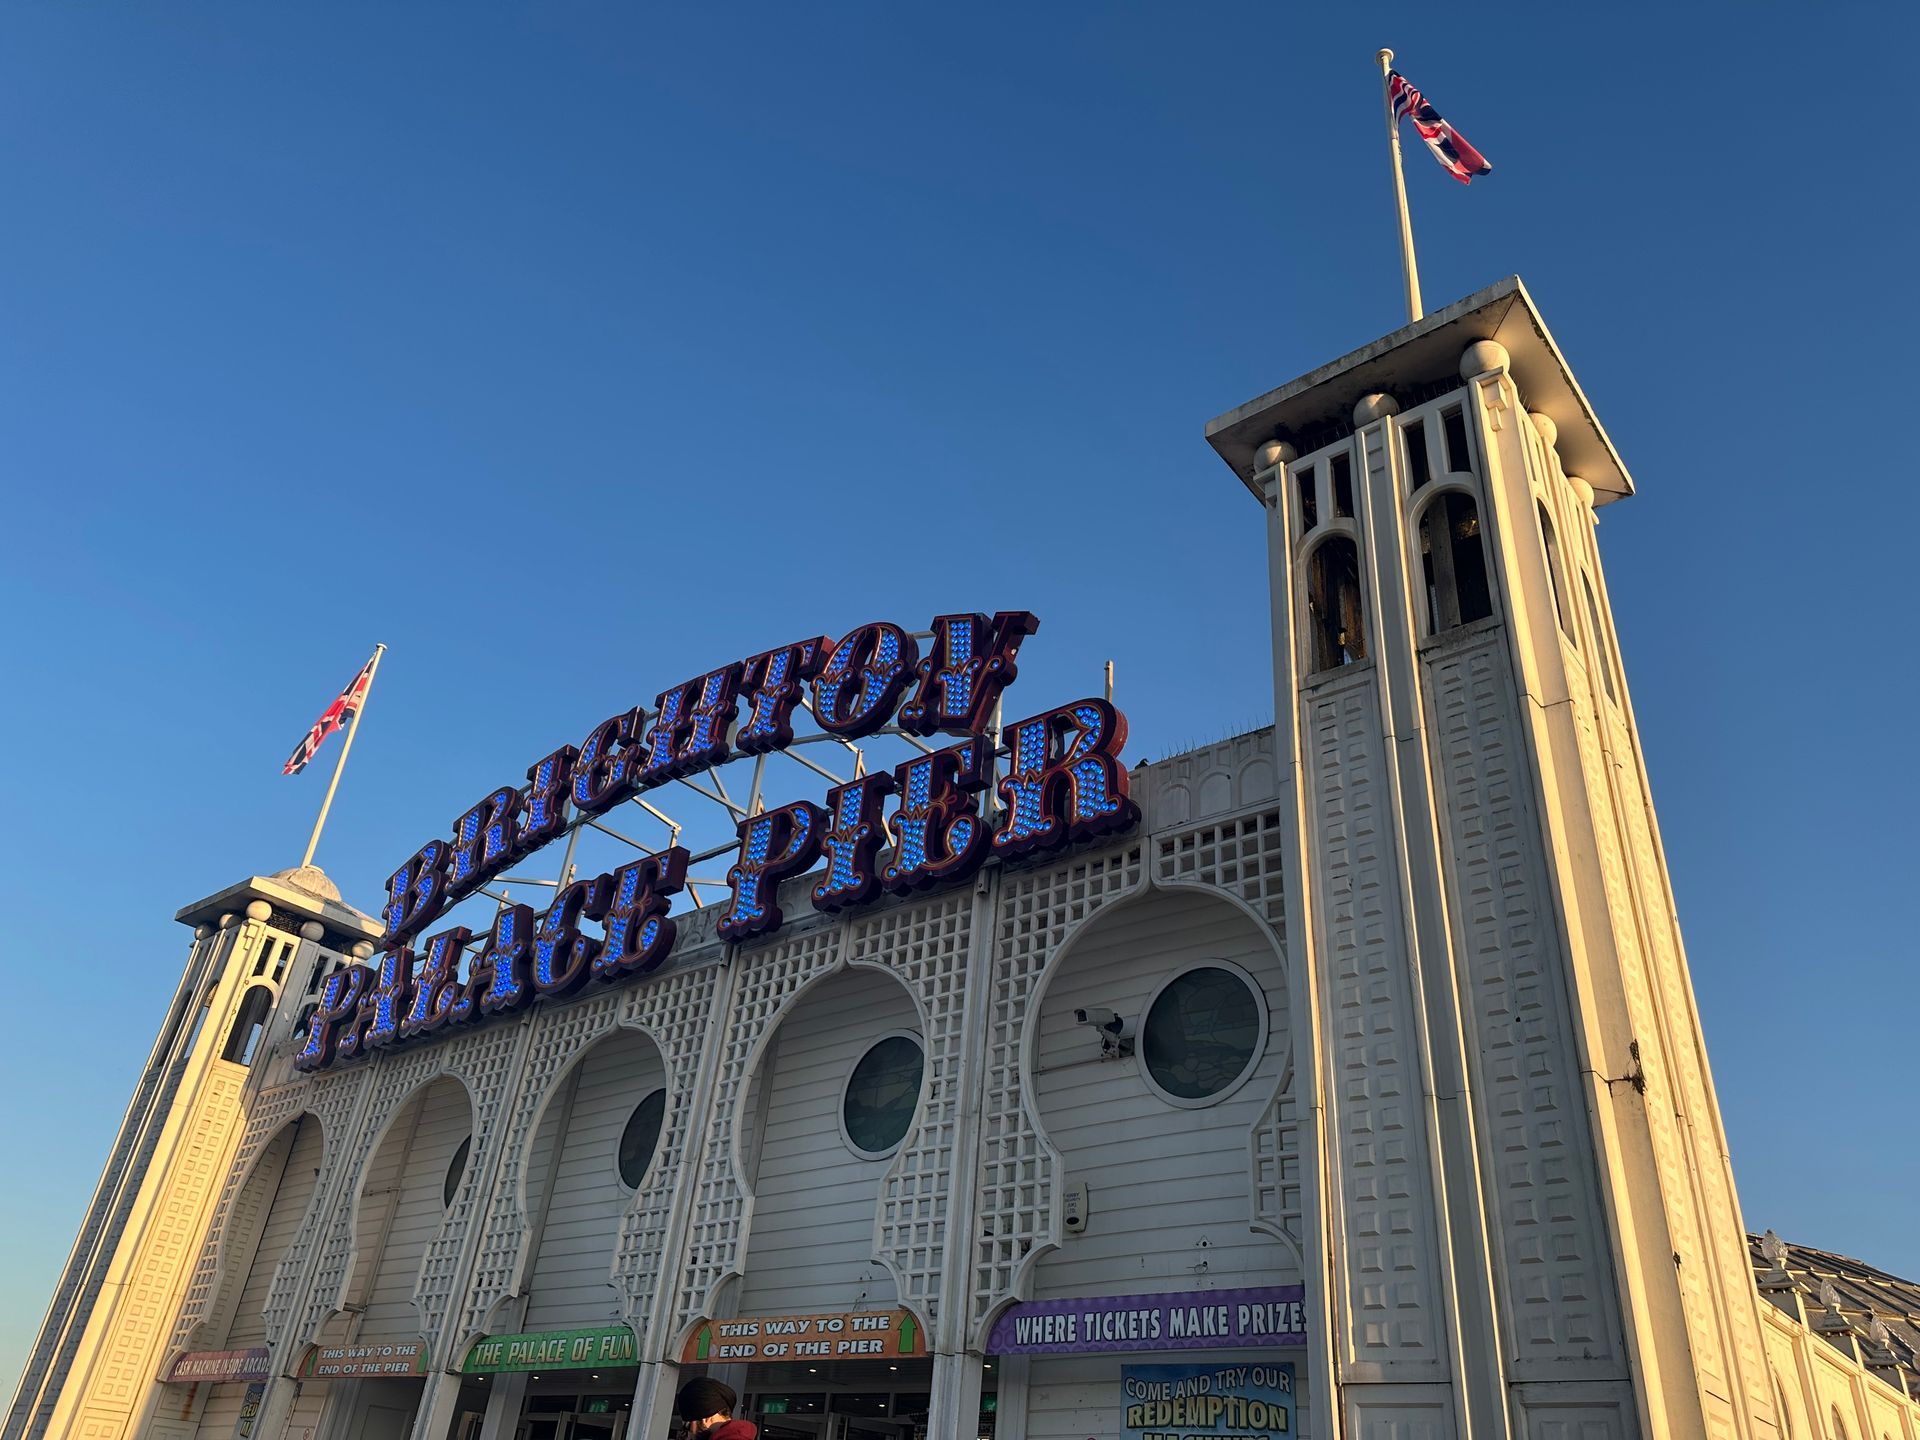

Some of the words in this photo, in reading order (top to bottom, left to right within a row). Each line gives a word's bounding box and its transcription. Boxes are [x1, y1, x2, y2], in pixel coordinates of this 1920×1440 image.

[379, 611, 1040, 951] BRIGHTON
[294, 846, 690, 1072] PALACE
[717, 698, 1142, 943] PIER
[719, 1322, 760, 1337] THIS
[764, 1320, 811, 1335] WAY
[816, 1318, 845, 1333] TO
[851, 1315, 890, 1331] THE
[1014, 1313, 1078, 1345] WHERE
[1083, 1308, 1162, 1341] TICKETS
[1168, 1304, 1229, 1338] MAKE
[322, 1349, 345, 1359] THIS
[347, 1347, 375, 1358] WAY
[377, 1346, 392, 1356] TO
[395, 1345, 418, 1355] THE
[473, 1342, 503, 1366] THE
[506, 1339, 567, 1364] PALACE
[571, 1337, 594, 1361] OF
[598, 1334, 635, 1360] FUN
[719, 1344, 757, 1359] END
[762, 1342, 788, 1357] OF
[794, 1341, 832, 1355] THE
[837, 1339, 884, 1354] PIER
[174, 1360, 193, 1376] CASH
[190, 1359, 222, 1375] MACHINE
[220, 1358, 244, 1374] INSIDE
[318, 1365, 340, 1375] END
[343, 1364, 358, 1373] OF
[361, 1363, 382, 1373] THE
[384, 1362, 410, 1372] PIER
[1125, 1377, 1171, 1401] COME
[1174, 1375, 1211, 1398] AND
[1215, 1367, 1248, 1390] TRY
[1251, 1366, 1291, 1393] OUR
[1127, 1396, 1289, 1431] REDEMPTION
